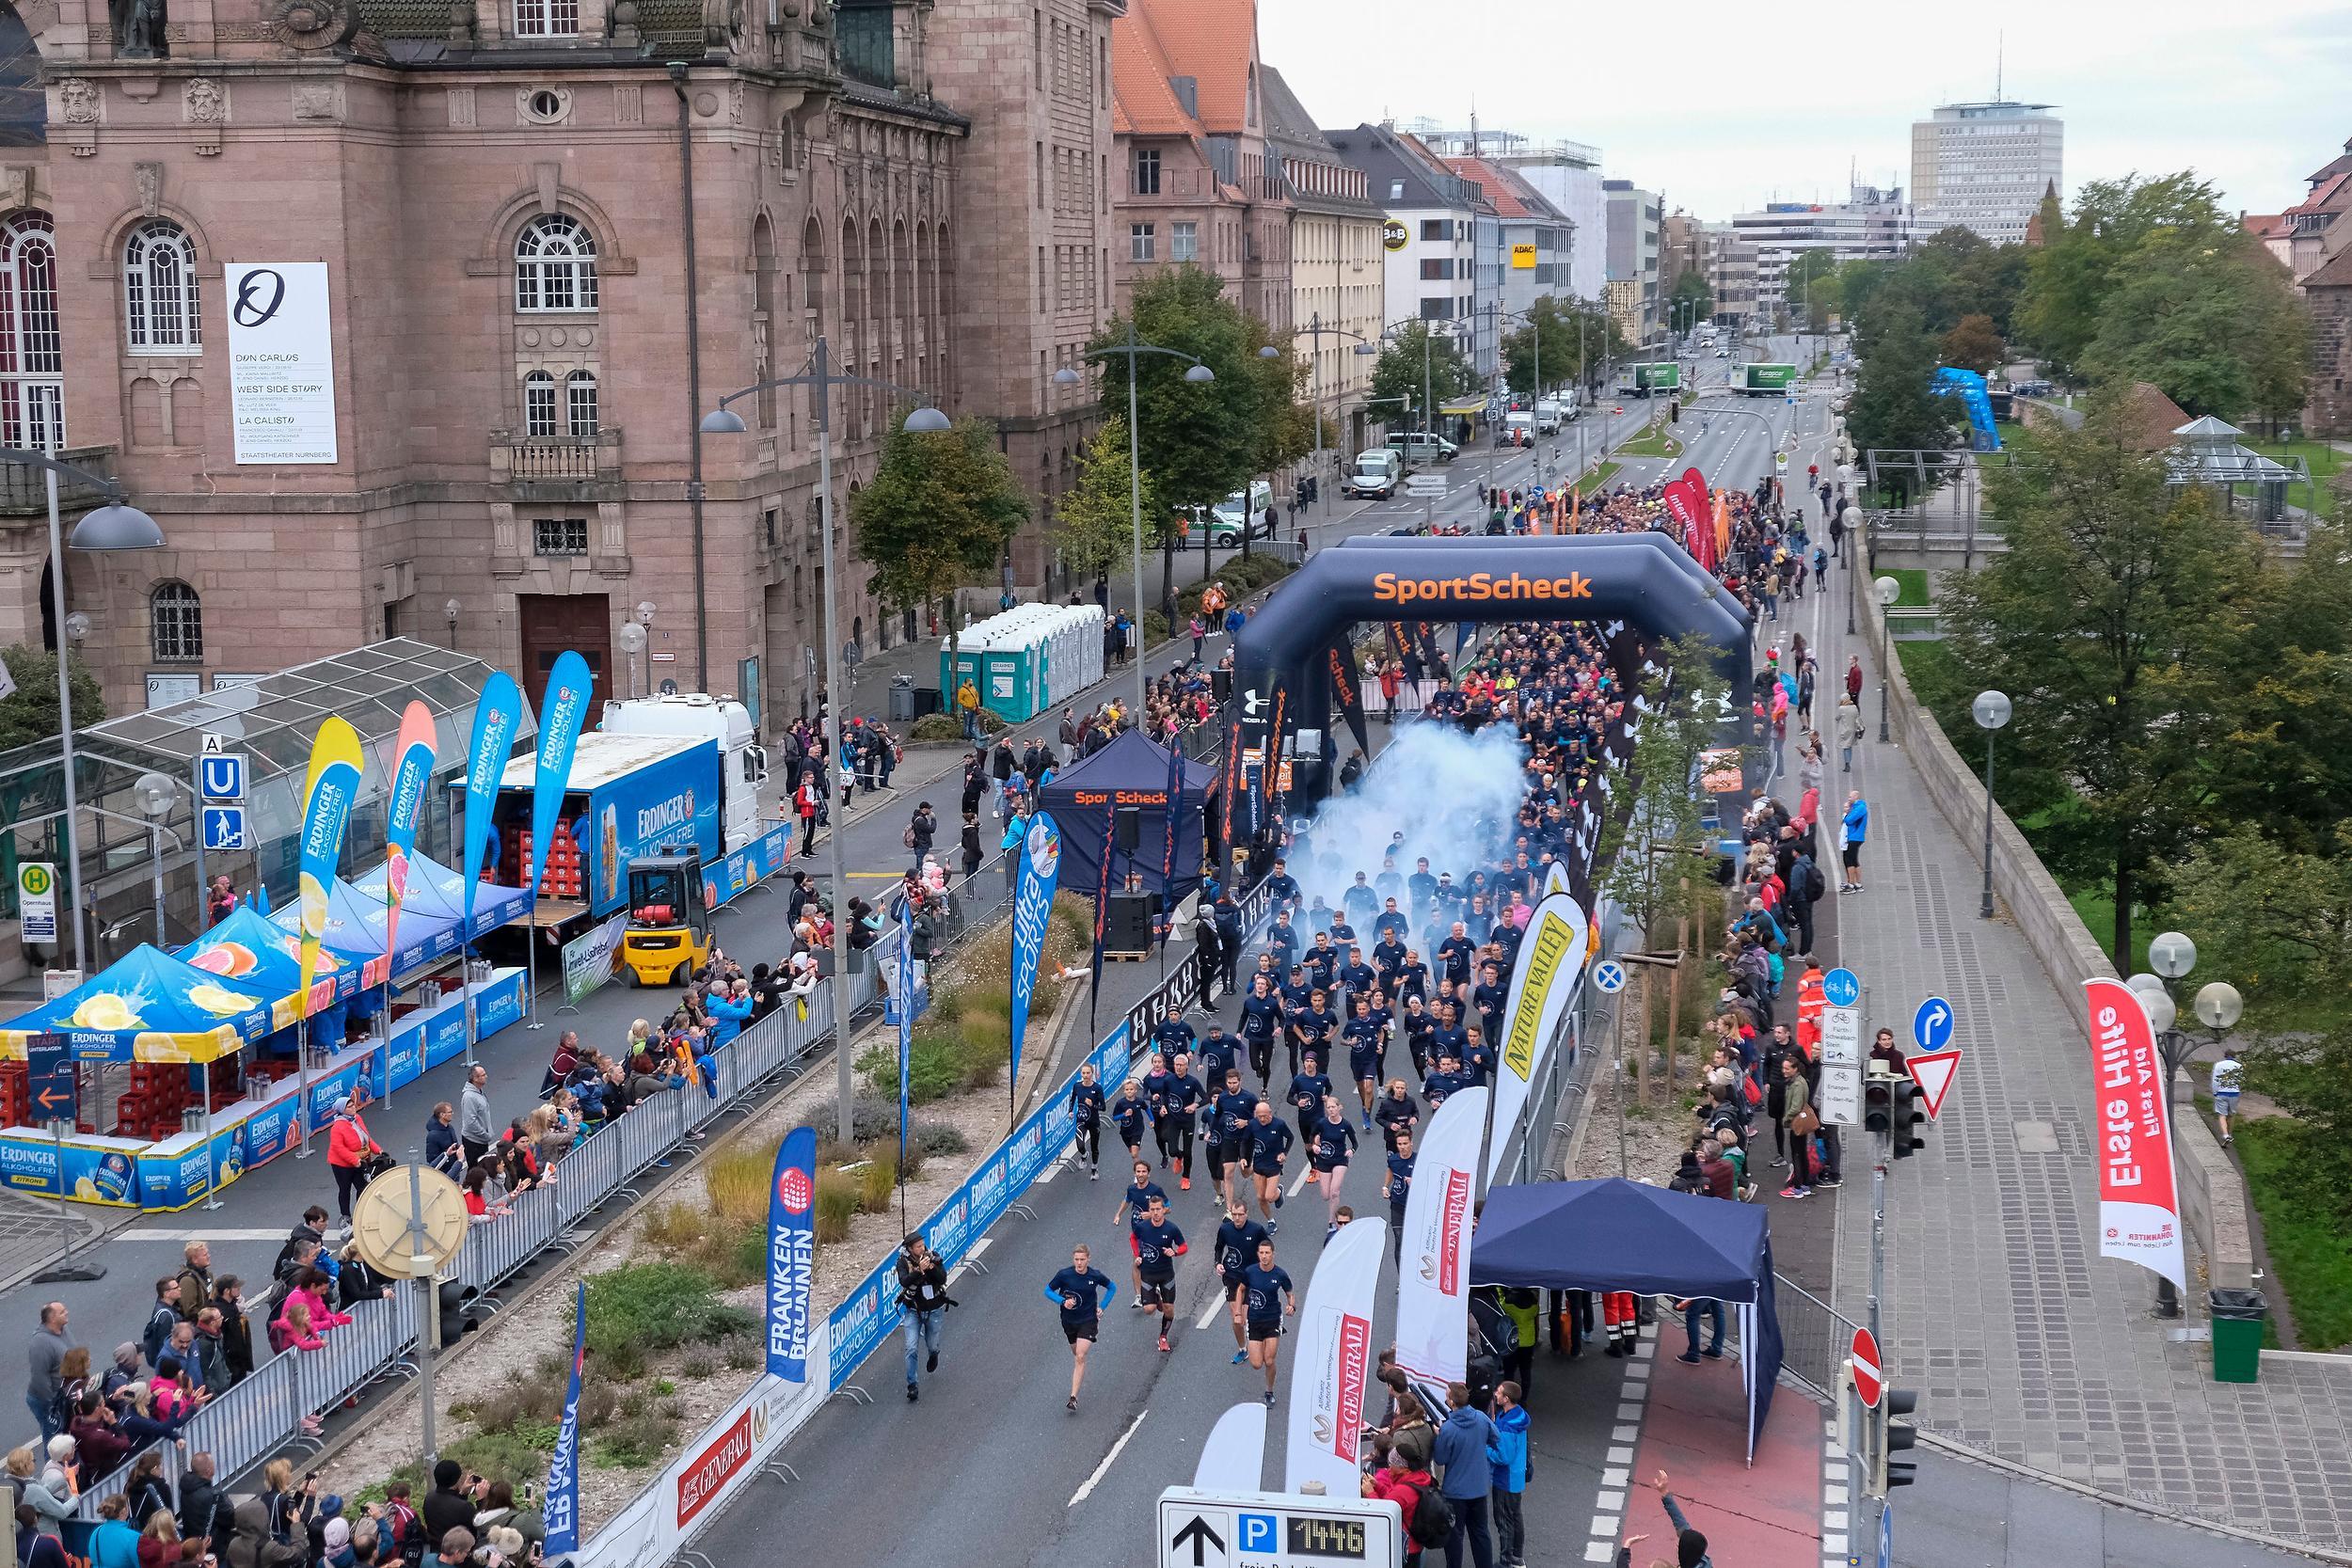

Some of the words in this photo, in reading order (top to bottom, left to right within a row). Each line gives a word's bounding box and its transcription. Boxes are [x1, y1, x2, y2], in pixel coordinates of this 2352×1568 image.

[1514, 245, 1534, 254] ADAC
[235, 354, 257, 362] DON
[260, 353, 299, 362] CARLOS
[237, 385, 264, 393] WEST
[266, 385, 289, 393] SIDE
[291, 385, 323, 393] STORY
[239, 417, 252, 425] LA
[254, 416, 294, 425] CALISTO
[1374, 571, 1593, 605] SportScheck
[205, 736, 219, 752] A
[541, 702, 567, 769] ERDINGER
[553, 689, 579, 774] ALKOHOLFREI
[470, 723, 498, 796] ERDINGER
[484, 713, 508, 799] ALKOHOLFREI
[208, 761, 234, 794] U
[393, 759, 417, 830] ERDINGER
[637, 793, 685, 840] ERDINGER
[1074, 791, 1168, 805] SporScheck
[306, 781, 336, 858] ERDINGER
[320, 786, 343, 863] ALKOHOLFREI
[639, 823, 696, 860] ALKOHOLFREI
[28, 872, 43, 889] H
[1017, 889, 1050, 1008] SPORTS
[1508, 988, 1540, 1071] NATURE
[1530, 918, 1567, 987] VALLEY
[244, 1009, 266, 1026] ERDINGER
[28, 1037, 61, 1046] START
[72, 1032, 117, 1044] ERDINGER
[1103, 1035, 1125, 1071] ERDINGER
[252, 1113, 280, 1138] ERDINGER
[0, 1146, 57, 1167] ERDINGER
[1009, 1130, 1037, 1168] ERDINGER
[1009, 1146, 1042, 1189] ALKOHOLFREI
[0, 1163, 56, 1175] ALKOHOLFREI
[15, 1176, 43, 1185] ZITRONE
[98, 1167, 127, 1189] ERDINGER
[970, 1167, 1000, 1210] ERDINGER
[970, 1182, 1007, 1228] ALKOHOLFREI
[930, 1206, 961, 1251] ERDINGER
[771, 1225, 792, 1358] FRANKEN
[788, 1229, 814, 1360] BRUNNEN
[830, 1296, 869, 1353] ERDINGER
[831, 1315, 879, 1375] ALKOHOLFREI
[1343, 1321, 1364, 1425] GENERALI
[699, 1421, 750, 1497] GENERALI
[1246, 1517, 1269, 1548] P
[1295, 1517, 1364, 1553] 1446
